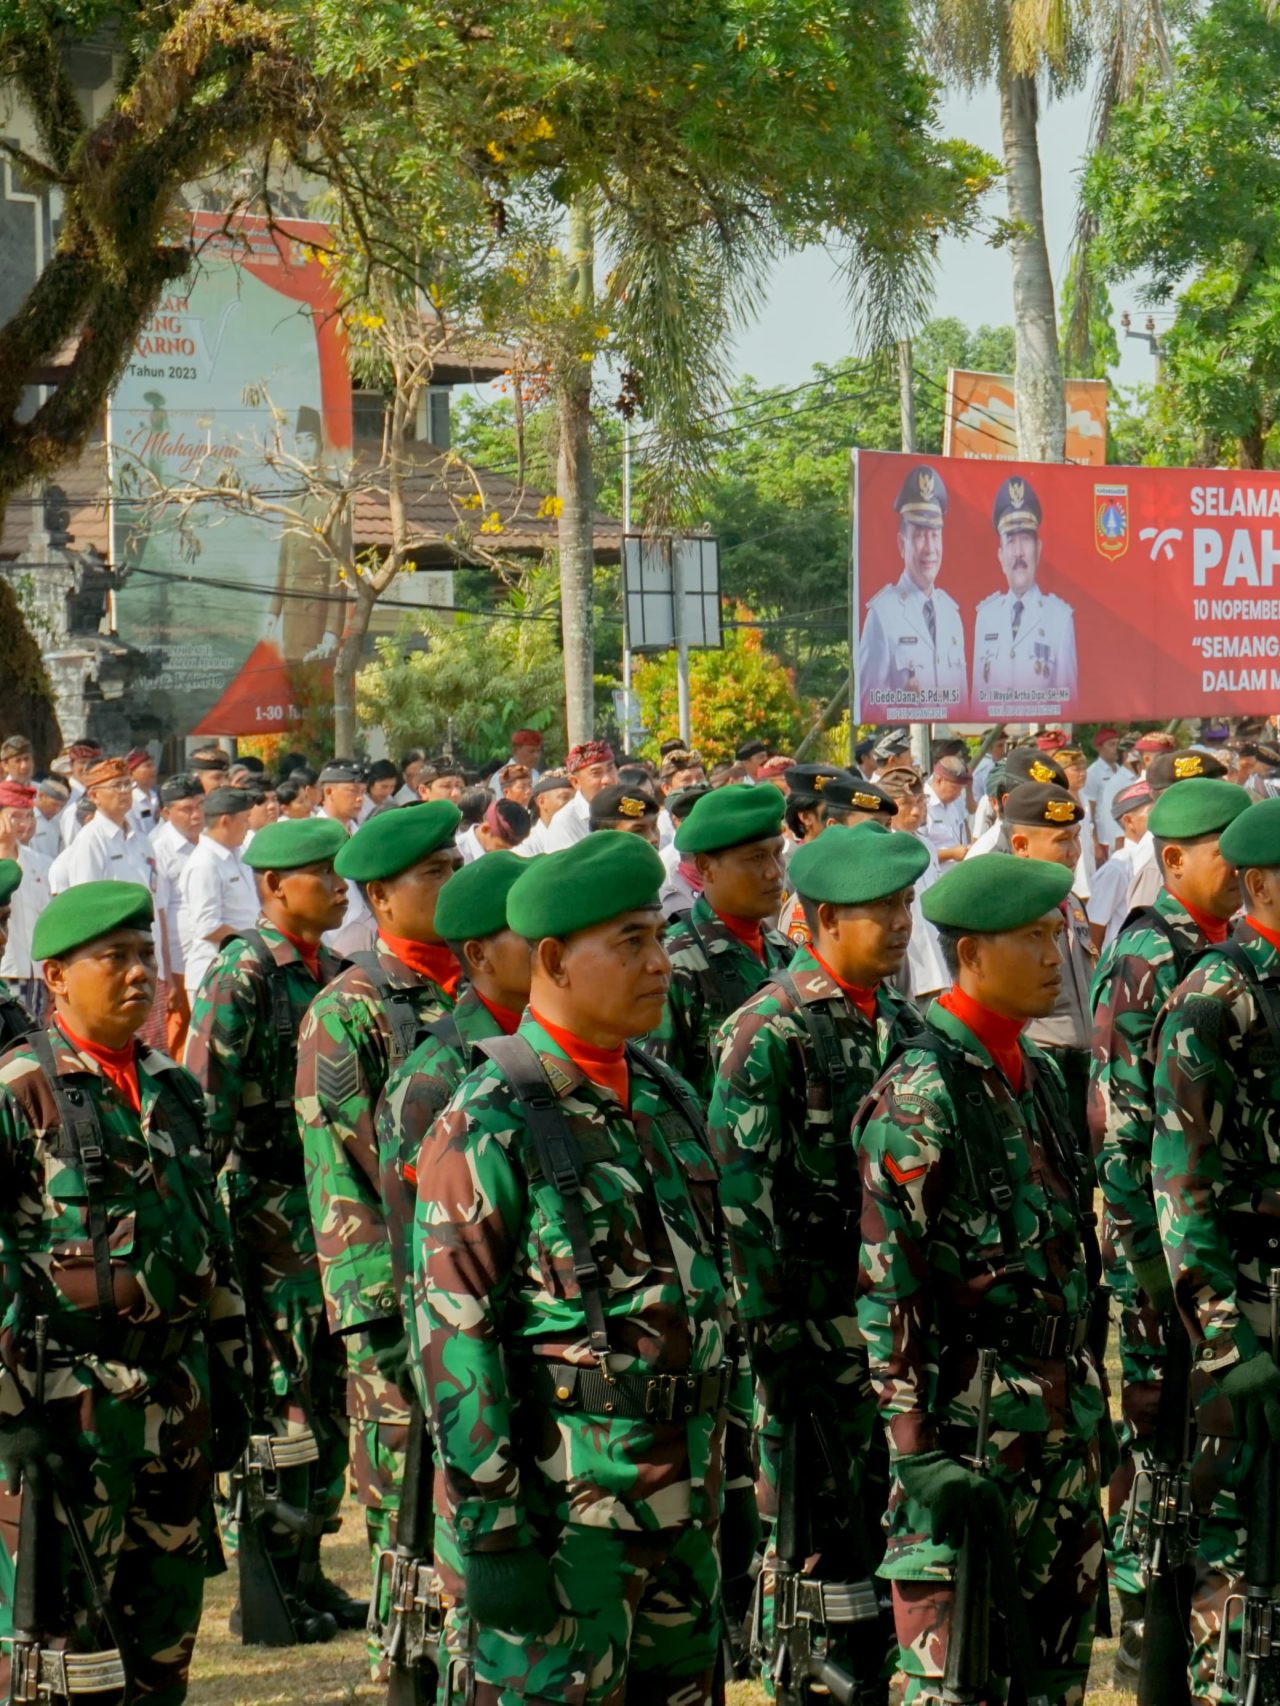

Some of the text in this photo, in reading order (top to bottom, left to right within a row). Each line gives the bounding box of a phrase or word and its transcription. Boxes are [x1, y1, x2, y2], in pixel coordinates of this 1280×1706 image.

[129, 365, 197, 380] Tahun 2023
[1193, 599, 1209, 620] 10
[1202, 669, 1267, 692] DALAM
[875, 690, 895, 703] Gede
[993, 690, 1013, 702] Wayan
[1014, 690, 1030, 701] Artha
[256, 705, 283, 721] 1-30
